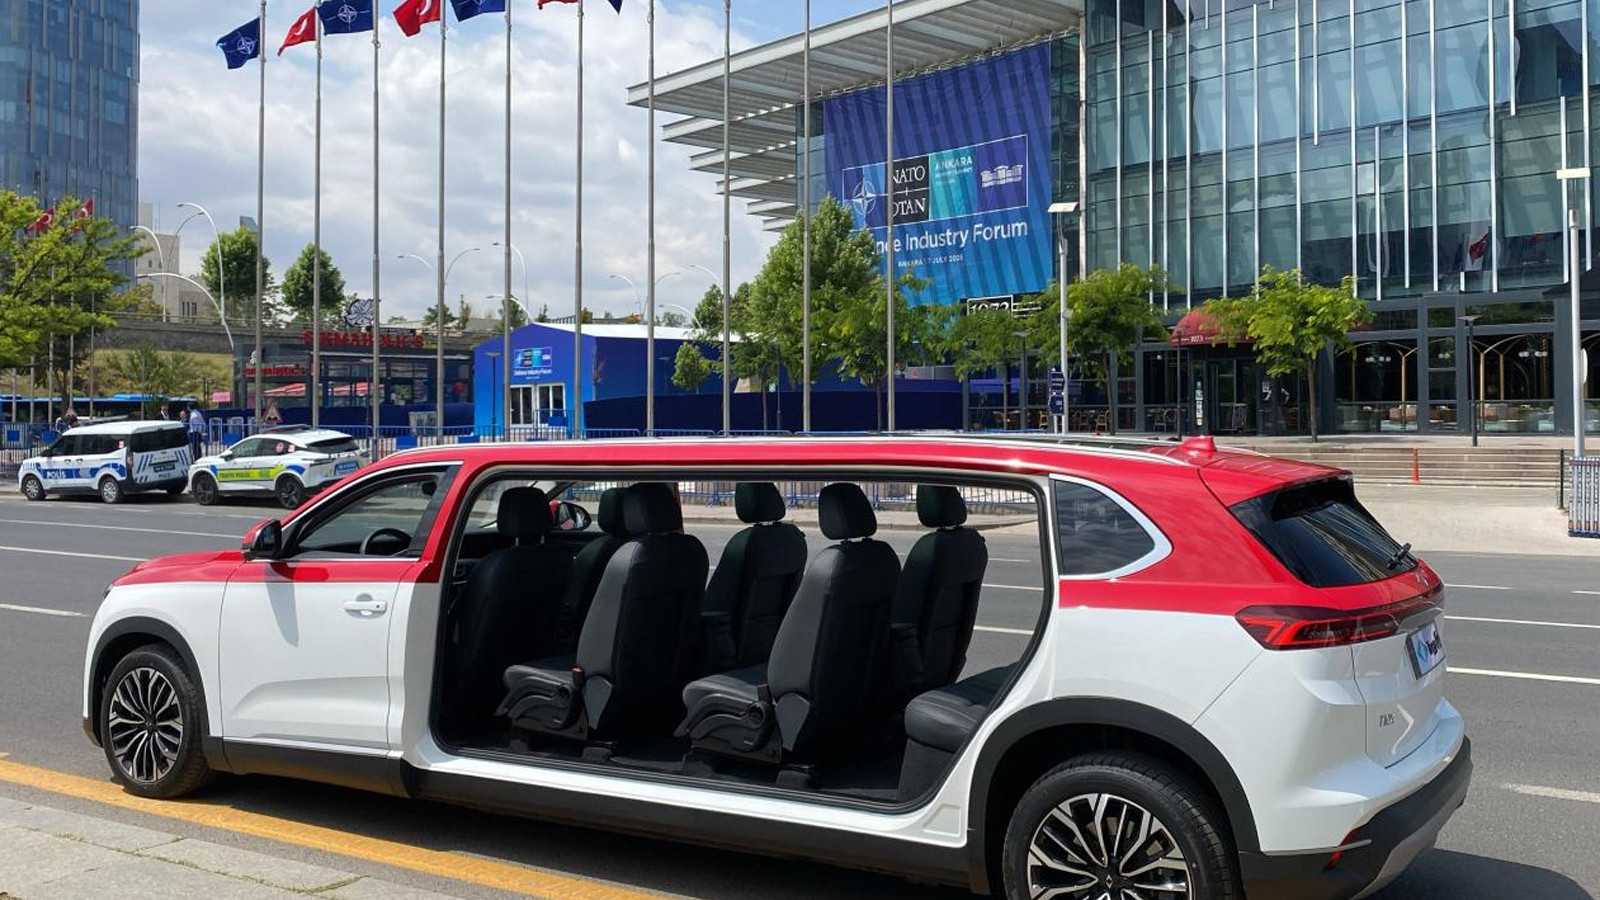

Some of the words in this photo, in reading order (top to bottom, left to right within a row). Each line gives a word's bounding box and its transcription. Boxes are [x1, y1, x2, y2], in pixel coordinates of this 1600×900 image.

[935, 156, 973, 170] ANKARA
[893, 165, 926, 184] NATO
[905, 229, 969, 250] Industry
[973, 221, 1028, 243] Forum
